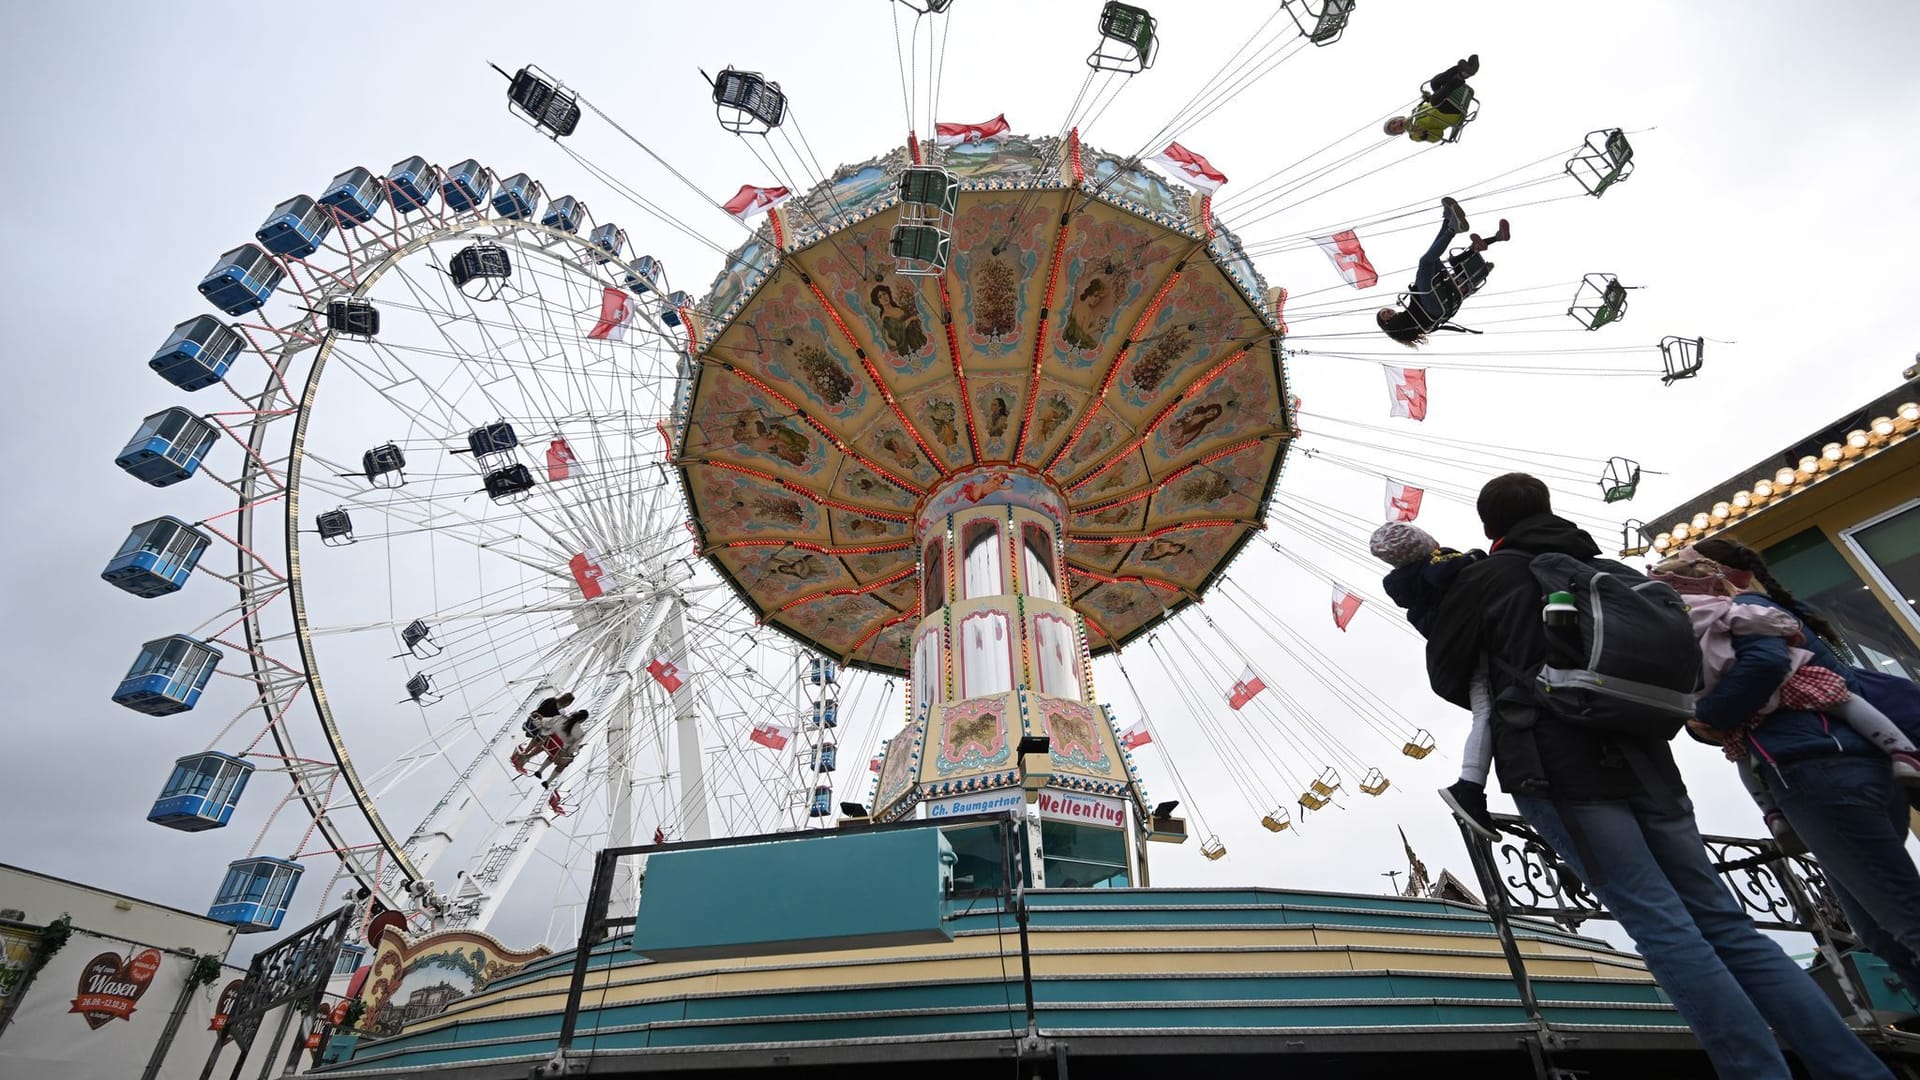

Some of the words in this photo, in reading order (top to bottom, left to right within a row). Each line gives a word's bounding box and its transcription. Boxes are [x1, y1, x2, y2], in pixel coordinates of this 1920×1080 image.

[932, 804, 948, 816] Ch.
[952, 796, 1021, 814] Baumgartner
[1039, 793, 1124, 826] Wellenflug
[88, 974, 138, 997] Wasen
